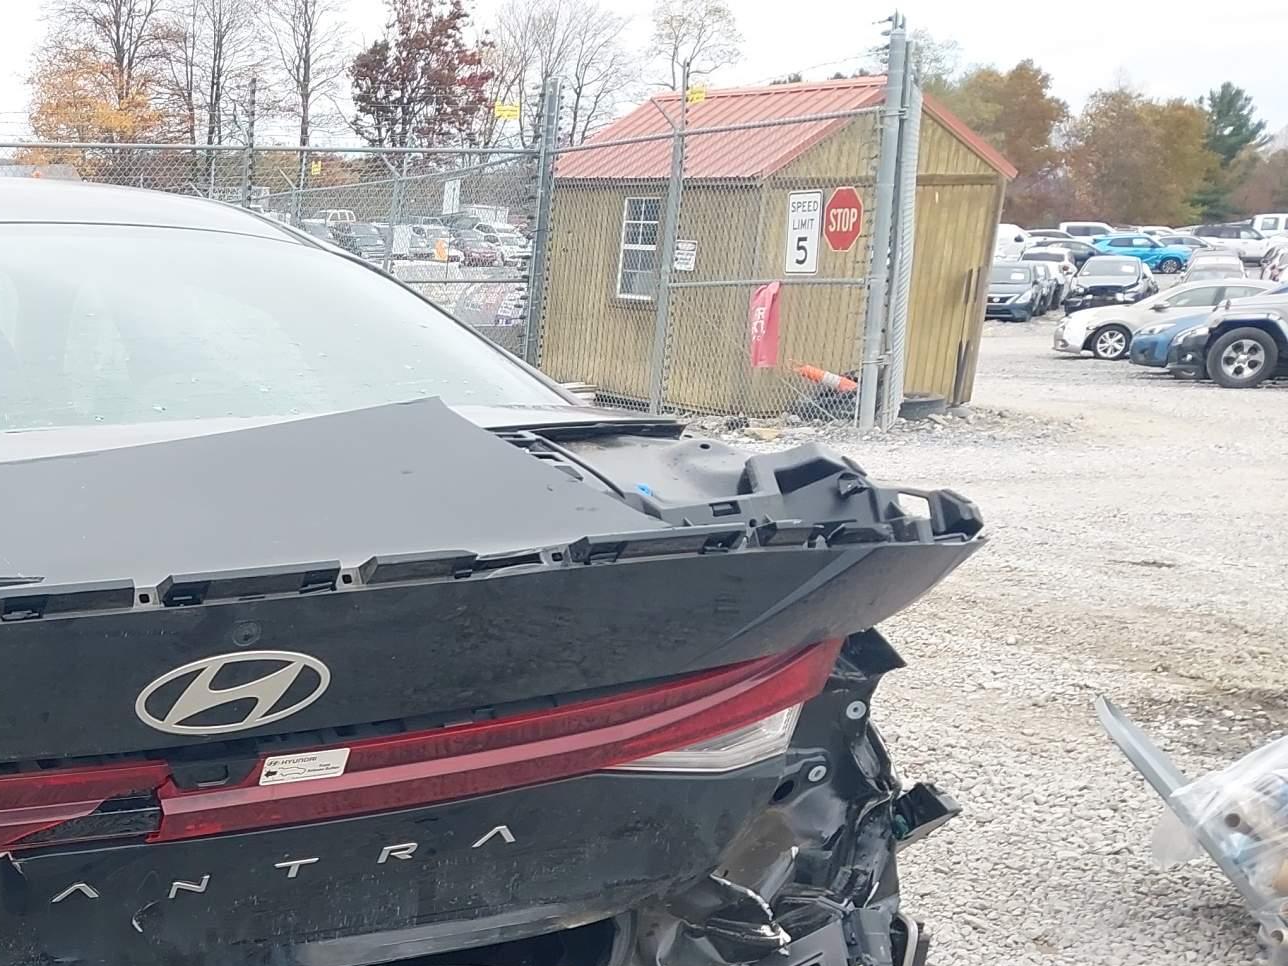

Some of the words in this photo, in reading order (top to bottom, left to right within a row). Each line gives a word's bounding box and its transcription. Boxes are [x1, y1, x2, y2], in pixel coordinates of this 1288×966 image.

[791, 200, 818, 213] SPEED
[793, 218, 814, 230] LIMIT
[828, 208, 858, 232] STOP
[795, 236, 808, 265] 5
